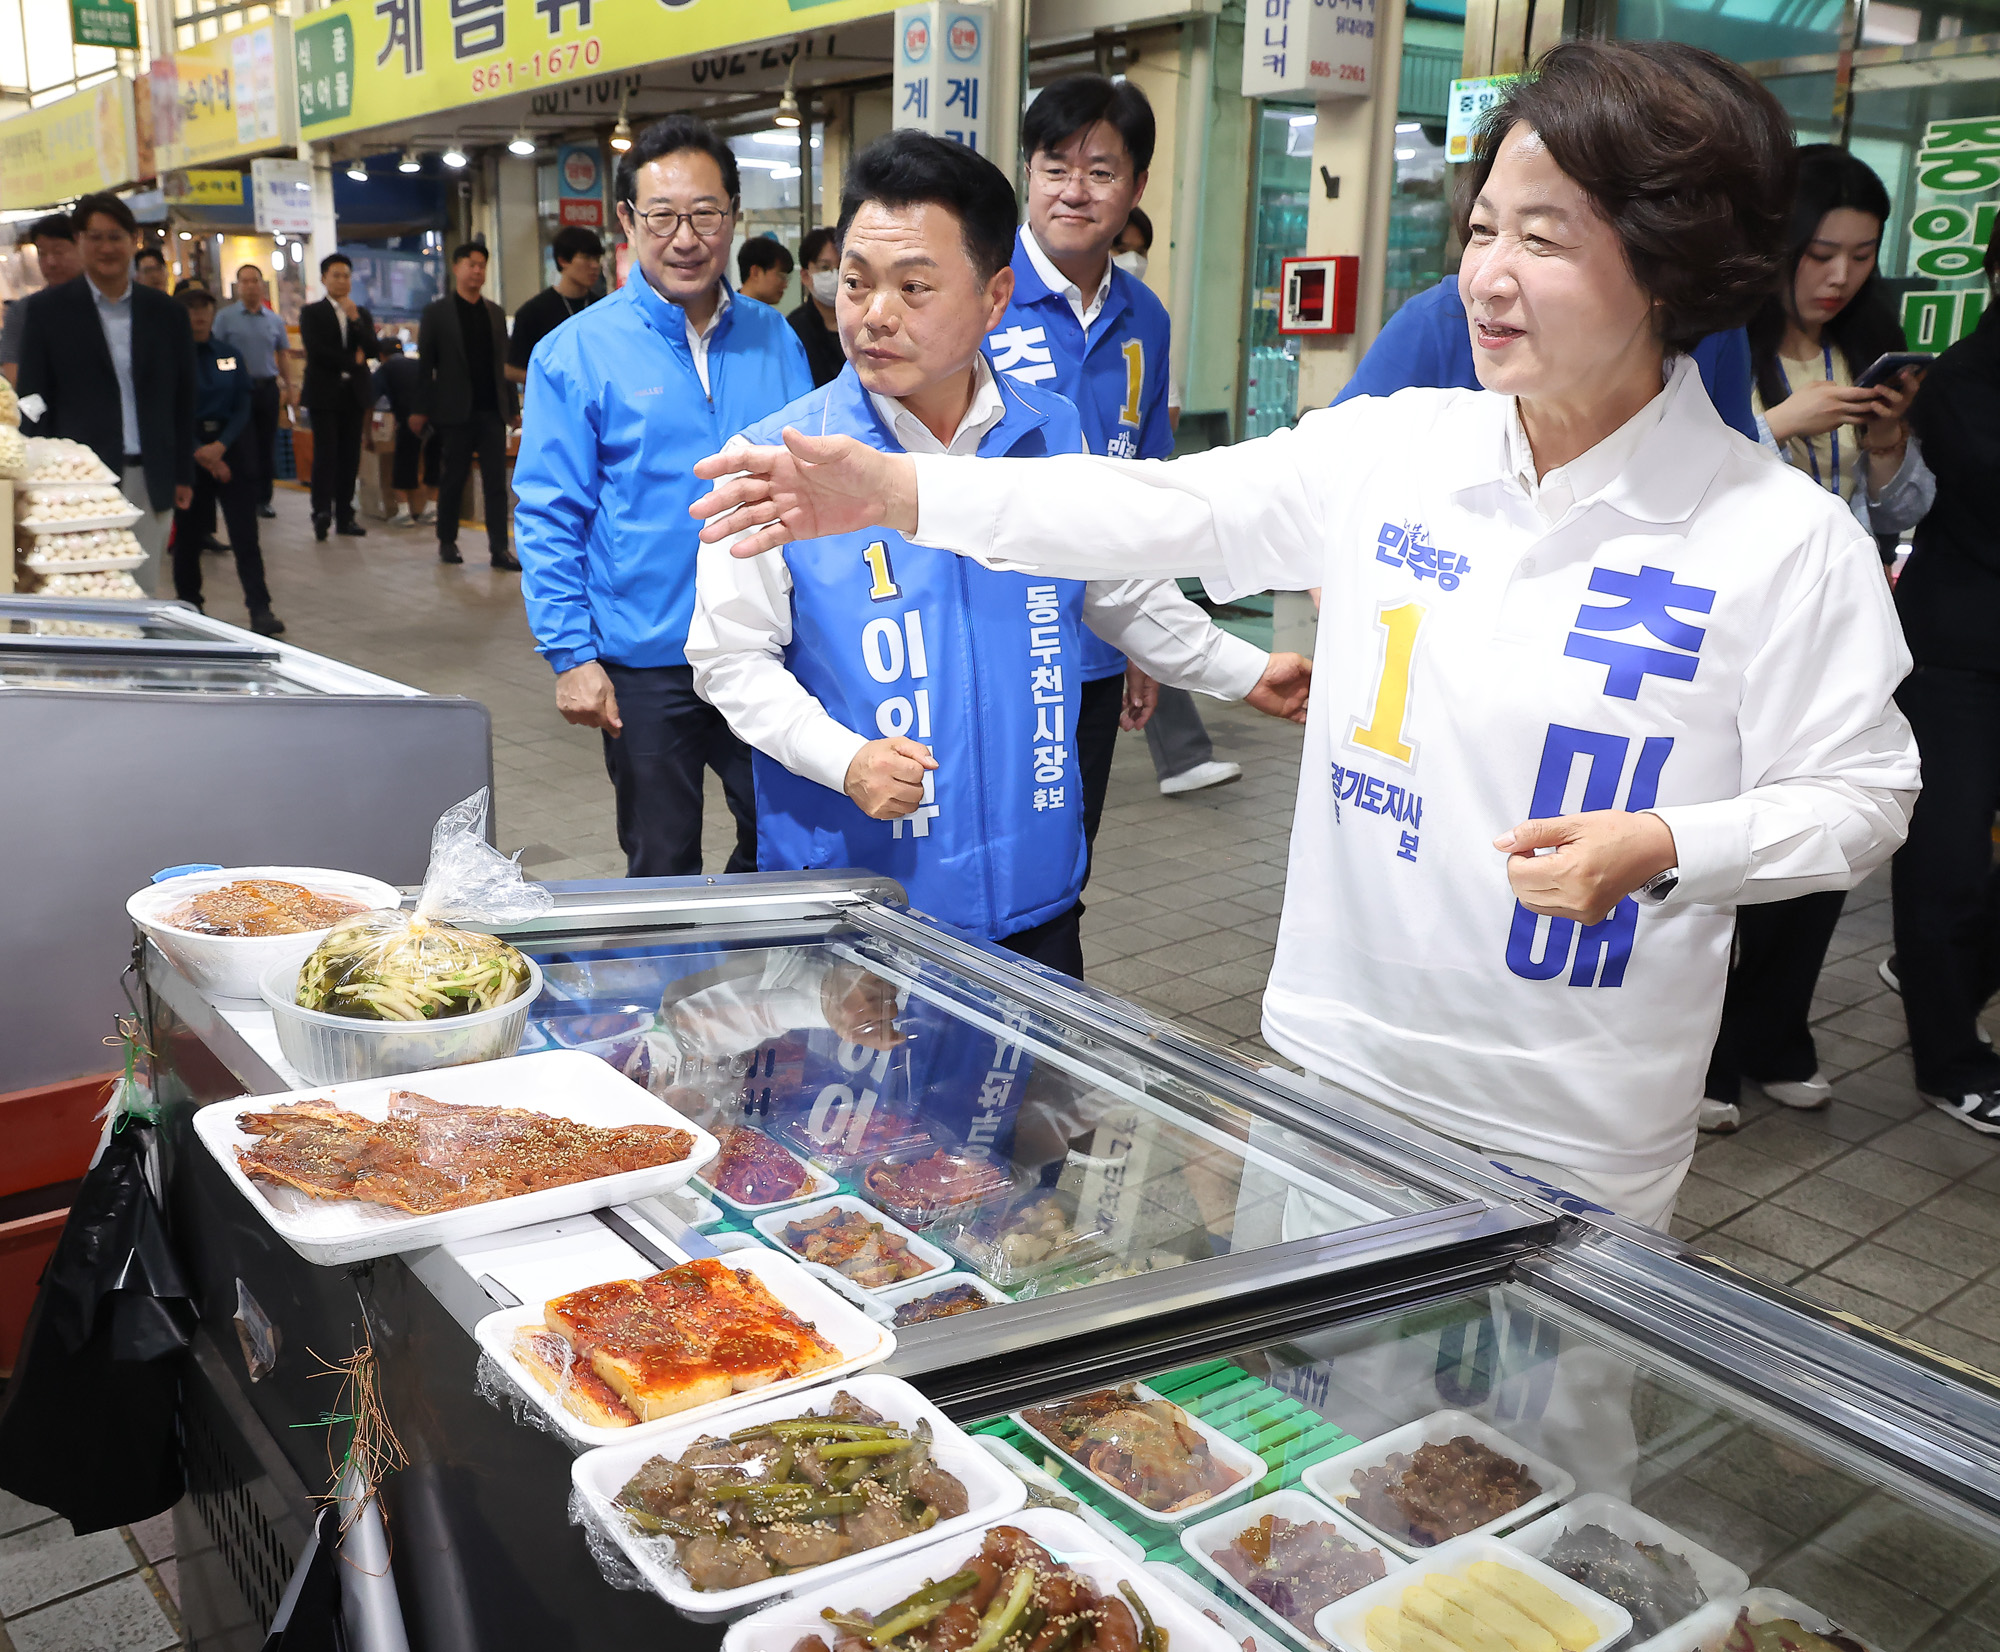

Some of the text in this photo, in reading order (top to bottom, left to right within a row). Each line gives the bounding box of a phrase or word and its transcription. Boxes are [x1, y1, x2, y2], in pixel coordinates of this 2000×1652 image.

[472, 40, 600, 93] 861-1670
[1119, 337, 1145, 430] 1
[862, 540, 902, 603] 1
[1376, 522, 1471, 592] 민주당
[1025, 585, 1068, 783] 동두천시장
[1345, 596, 1430, 773] 1
[1033, 786, 1065, 812] 후보
[1331, 762, 1423, 830] 경기도지사
